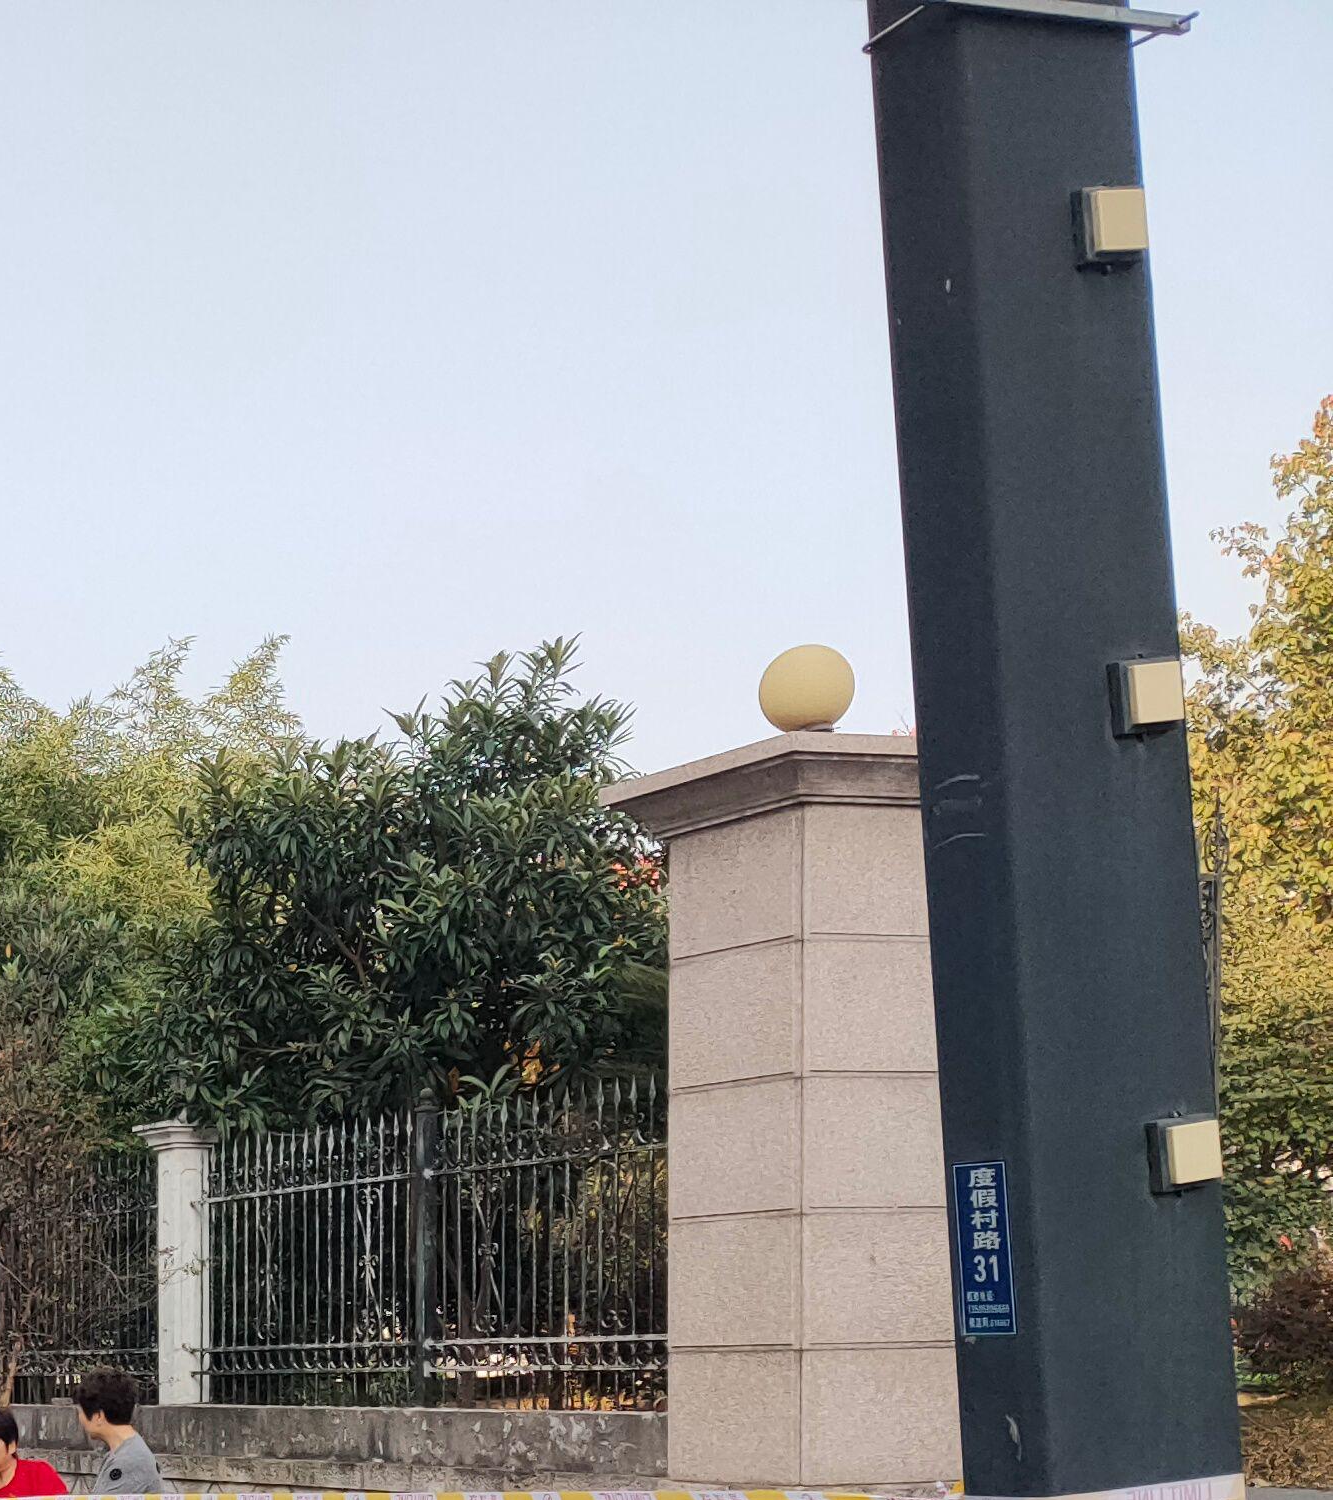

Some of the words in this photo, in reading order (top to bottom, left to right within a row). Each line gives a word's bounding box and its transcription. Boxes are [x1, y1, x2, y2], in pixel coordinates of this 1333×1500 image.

[968, 1167, 1001, 1250] 度假村路
[973, 1255, 1000, 1283] 31
